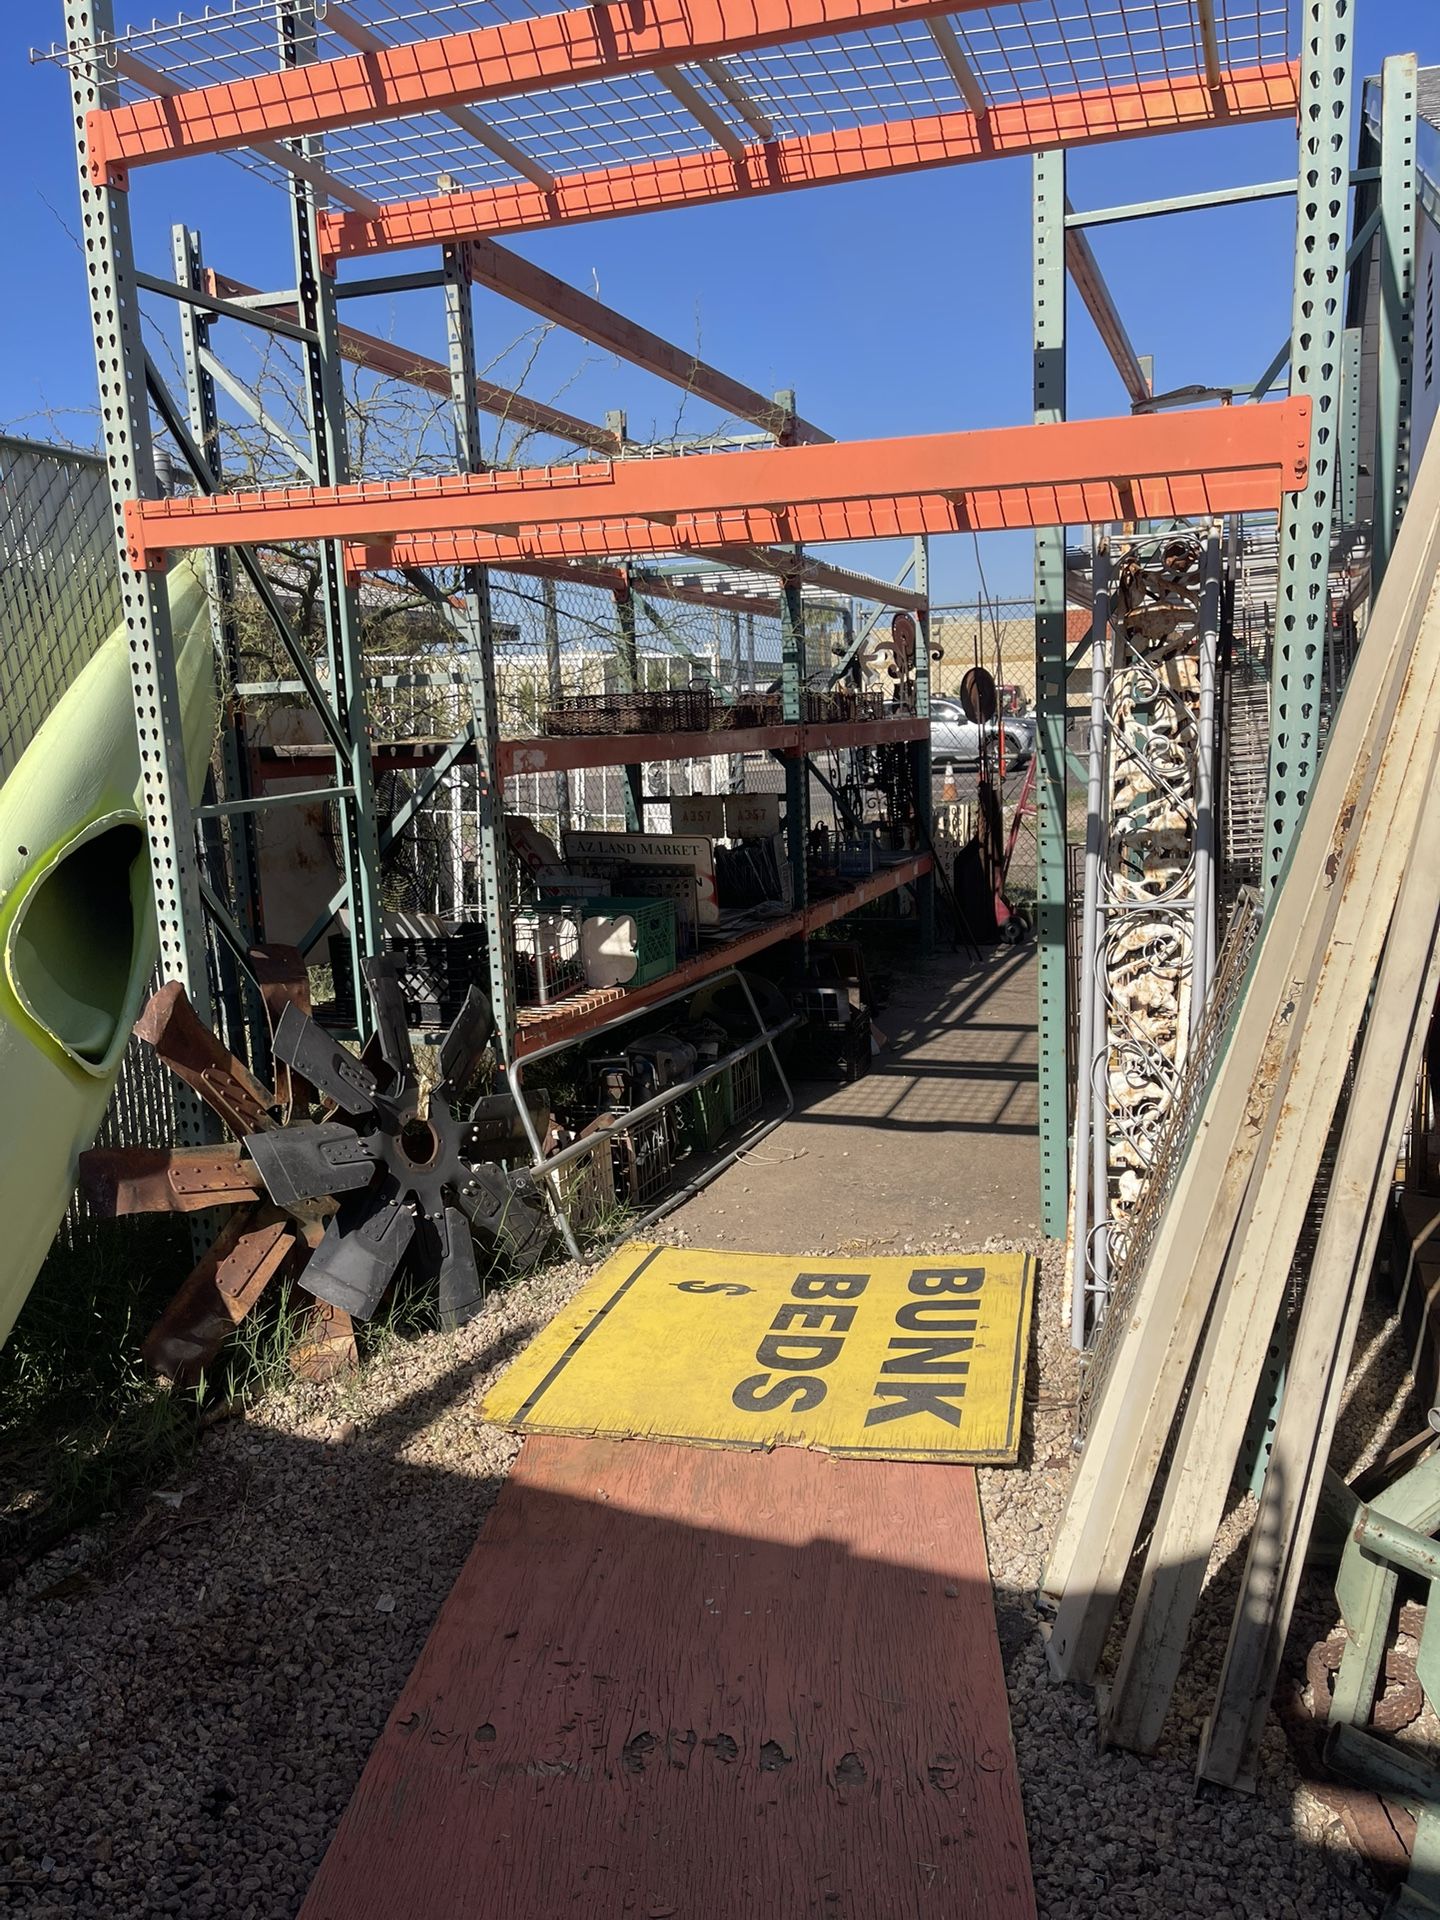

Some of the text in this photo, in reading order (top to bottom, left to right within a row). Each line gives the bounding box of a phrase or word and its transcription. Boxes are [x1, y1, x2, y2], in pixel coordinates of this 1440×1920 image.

[599, 841, 636, 854] LAND
[669, 1279, 757, 1297] $
[732, 1272, 872, 1414] BEDS
[864, 1267, 985, 1429] BUNK
